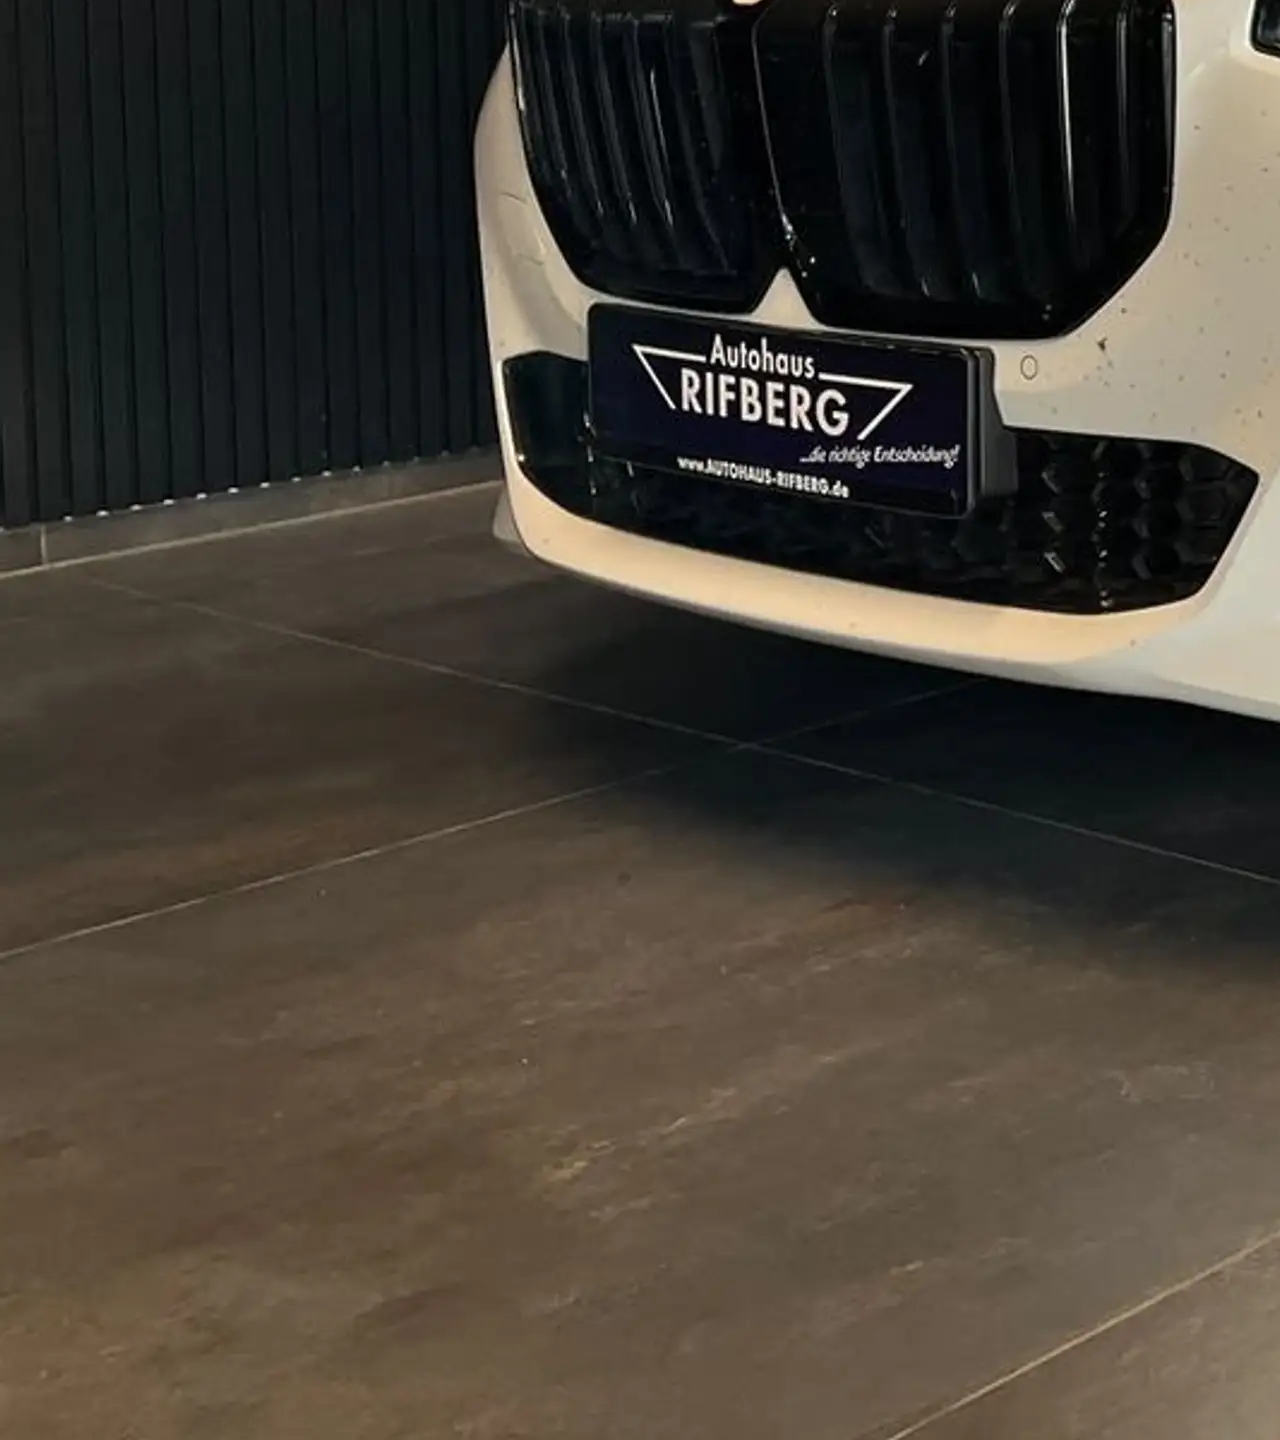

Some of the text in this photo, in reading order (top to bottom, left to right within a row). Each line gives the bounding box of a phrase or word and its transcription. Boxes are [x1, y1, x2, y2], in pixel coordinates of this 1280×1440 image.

[710, 333, 816, 379] Autohaus
[680, 367, 850, 437] RIFBERG
[676, 456, 850, 499] www.AUTOHAUS-RIFBERG.de
